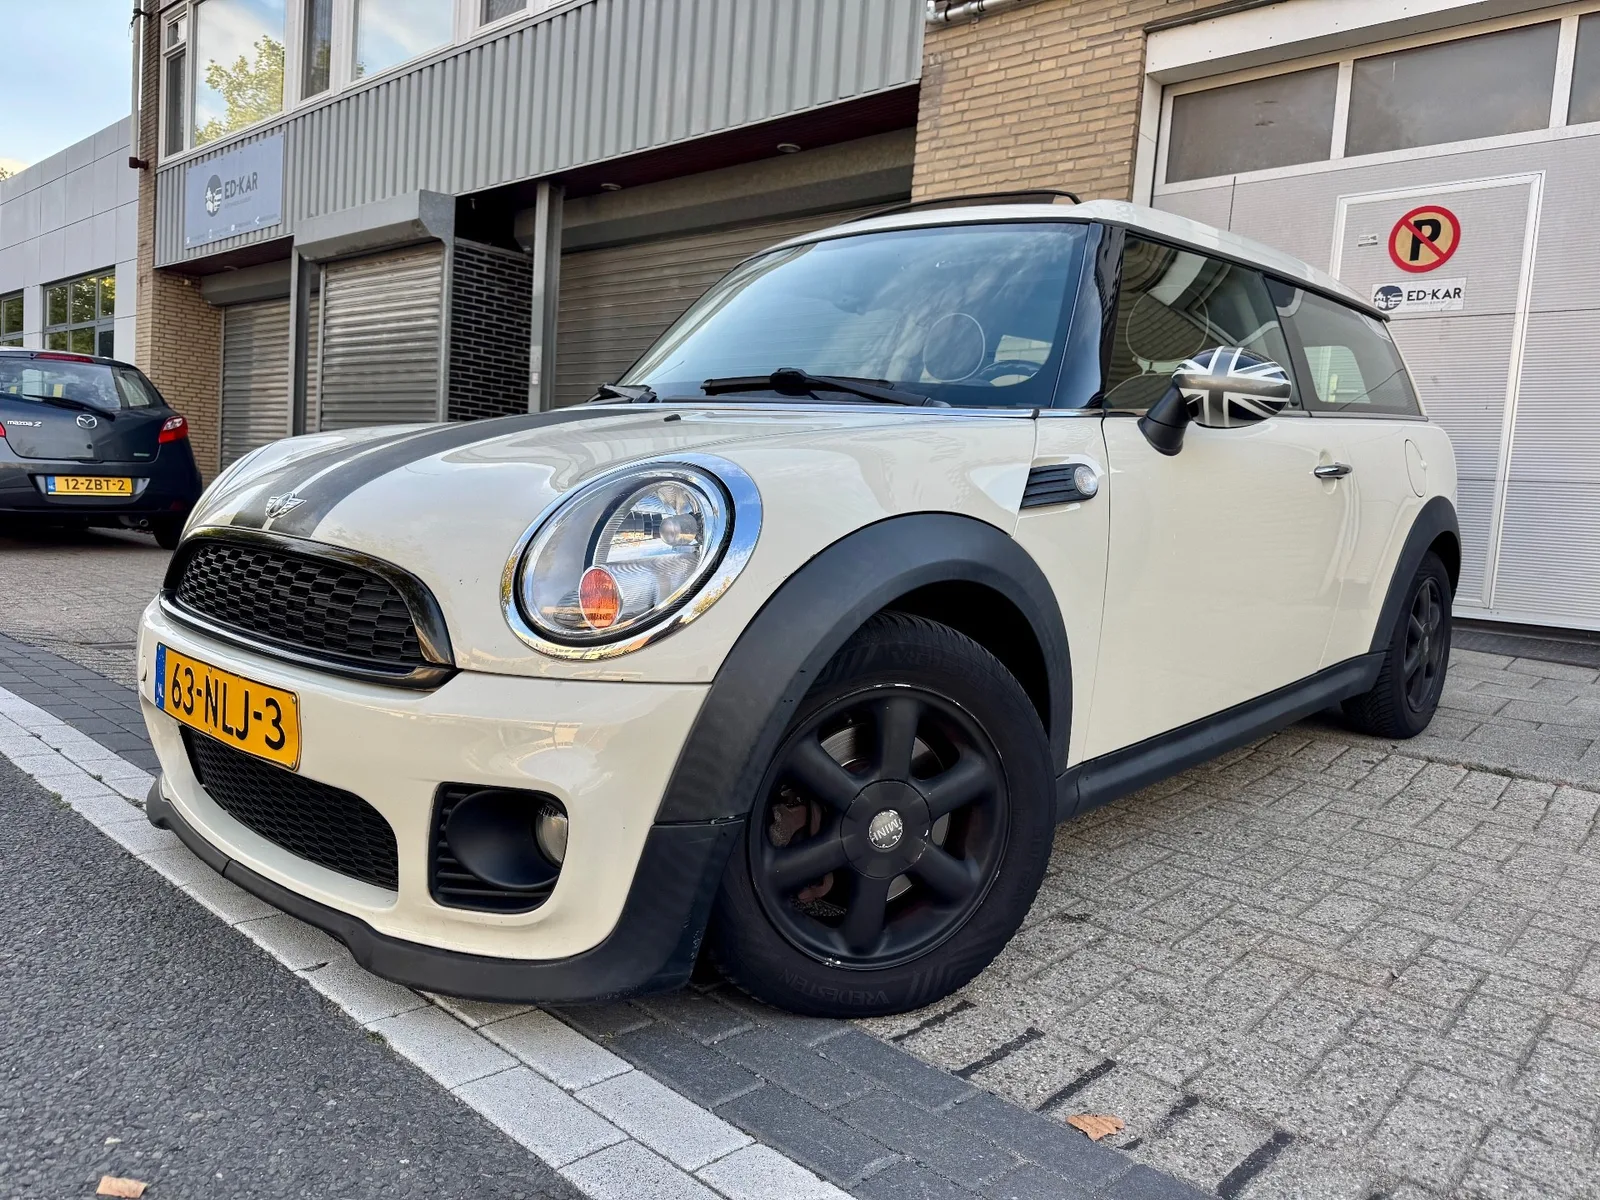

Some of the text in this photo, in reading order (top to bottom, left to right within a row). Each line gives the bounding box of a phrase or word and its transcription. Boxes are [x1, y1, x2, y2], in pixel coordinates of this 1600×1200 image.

[224, 172, 258, 199] ED-KAR
[1409, 218, 1442, 262] P
[1406, 287, 1462, 301] ED-KAR
[64, 478, 126, 491] 12-ZBT-2
[171, 662, 286, 751] 63-NLJ-3
[873, 819, 899, 840] MINI
[778, 967, 890, 1005] VREDESTEIN
